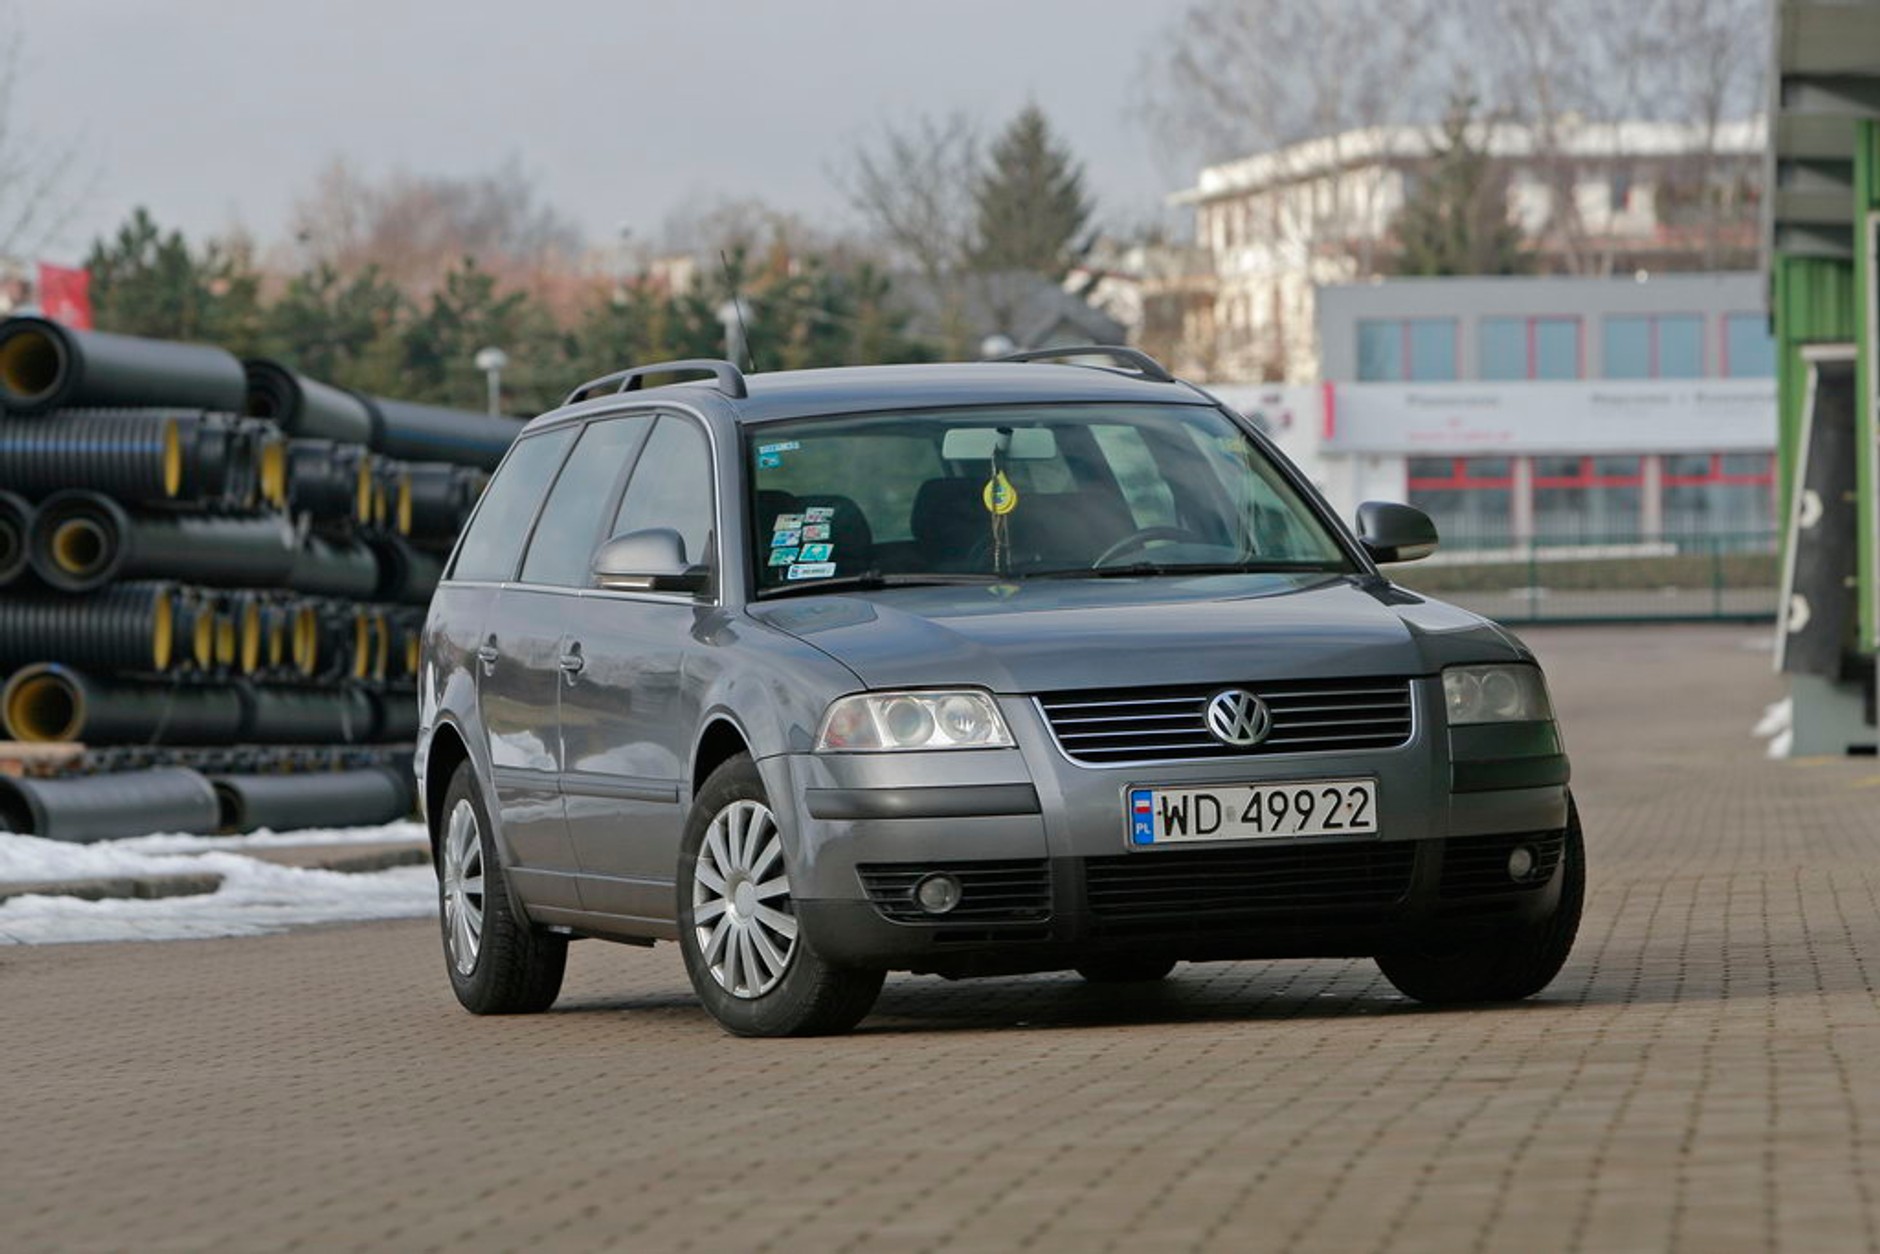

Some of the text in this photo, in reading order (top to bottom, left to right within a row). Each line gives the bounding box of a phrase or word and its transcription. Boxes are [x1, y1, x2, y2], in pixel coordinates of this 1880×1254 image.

[1161, 786, 1370, 836] WD 49922
[1135, 822, 1152, 835] PL
